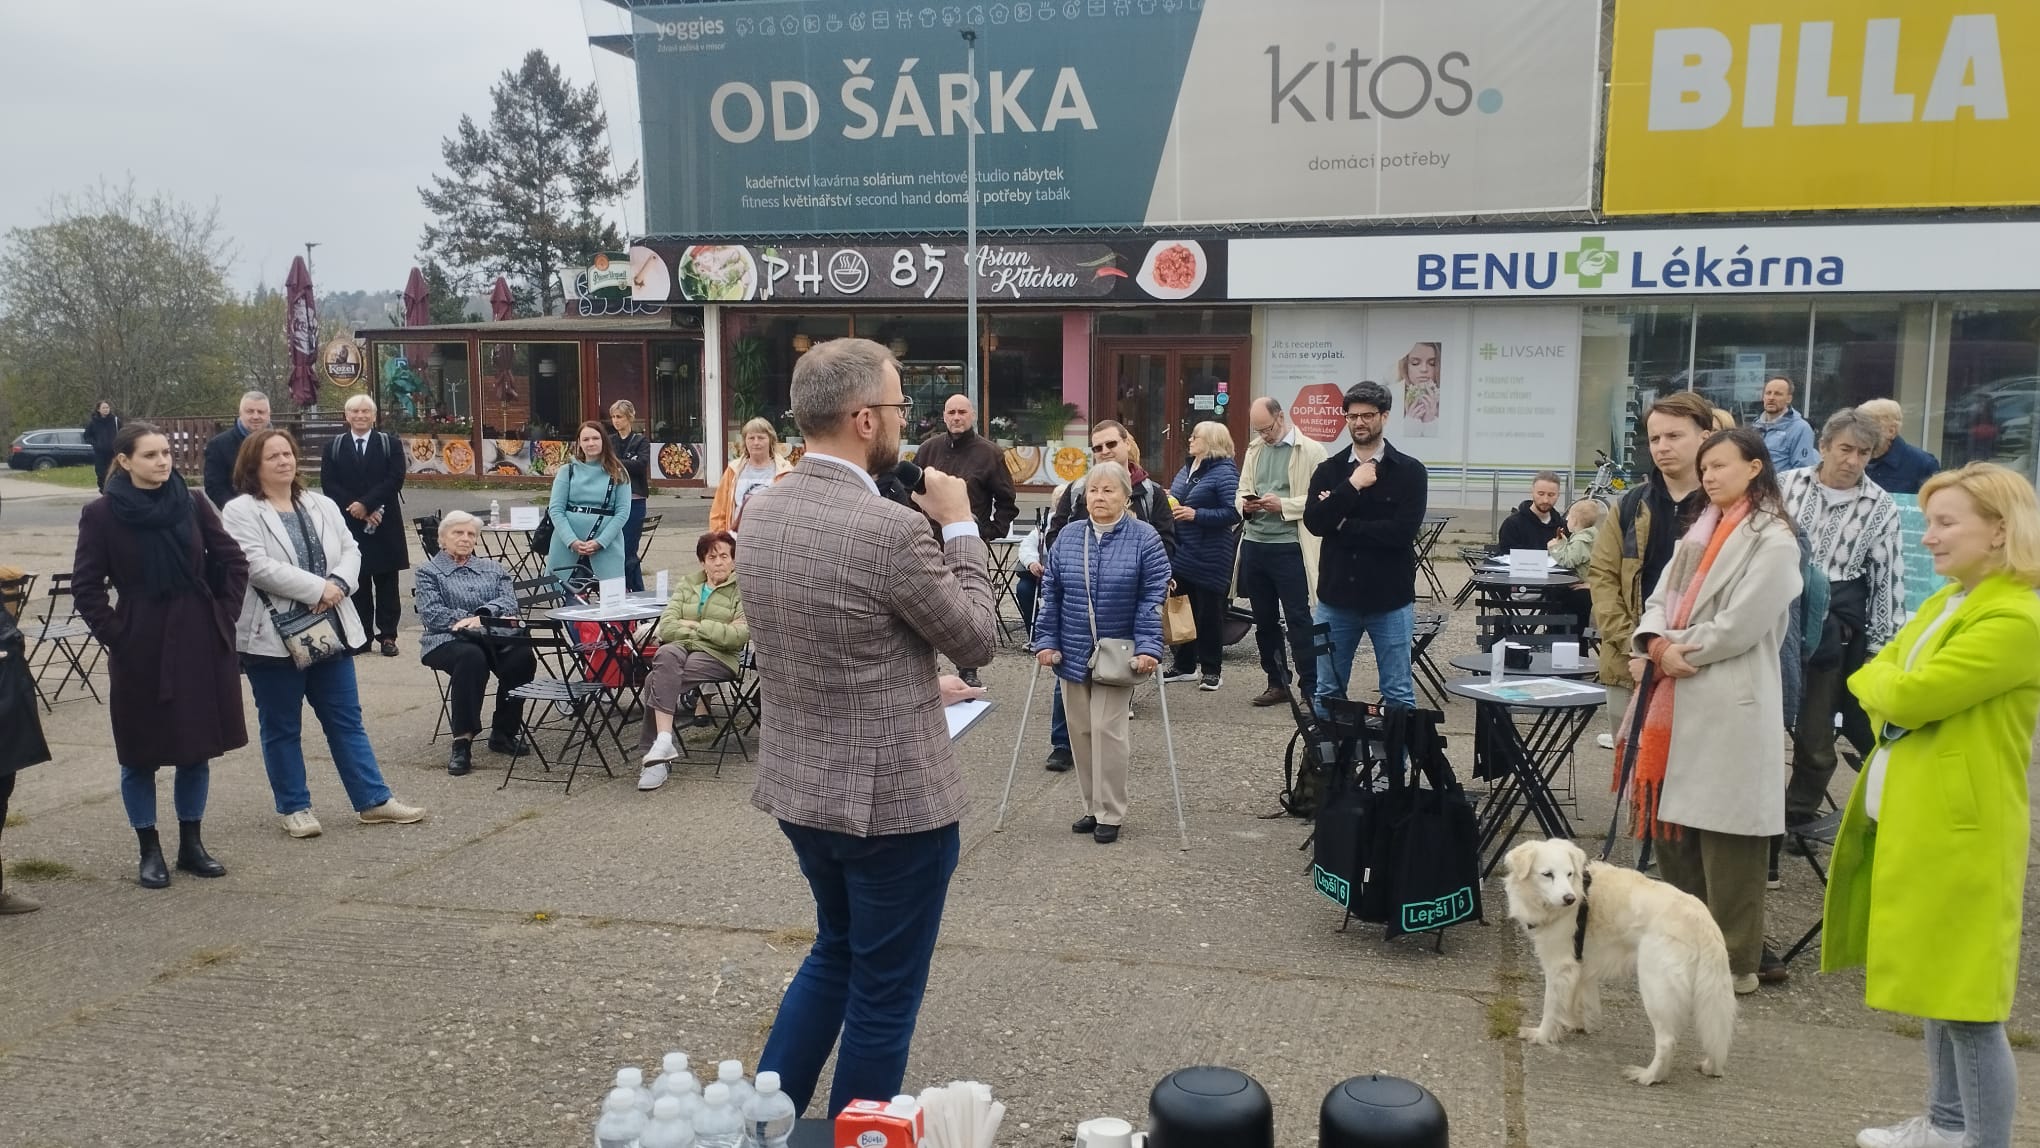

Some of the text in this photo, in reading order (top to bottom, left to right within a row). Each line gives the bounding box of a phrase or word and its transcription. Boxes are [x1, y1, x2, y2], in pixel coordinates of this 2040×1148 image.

[656, 16, 724, 41] yoggies
[1647, 13, 2010, 132] BILLA
[710, 58, 1098, 144] OD ŠÁRKA
[1308, 150, 1450, 172] domácí potřeby
[745, 174, 811, 189] kadeřnictví
[813, 173, 860, 187] kavárna
[863, 171, 915, 186] solárium
[918, 170, 968, 184] nehtové
[1013, 166, 1064, 185] nábytek
[741, 187, 1071, 208] fitness květinářství second hand domáí potřeby tabák
[889, 243, 946, 298] 85
[964, 245, 1031, 277] Asian
[1416, 243, 1844, 291] BENU Lékárna
[989, 265, 1078, 299] Kitchen
[1271, 351, 1277, 359] k
[1278, 350, 1297, 359] nám
[1291, 340, 1333, 350] receptem
[1501, 344, 1567, 358] LIVSANE
[328, 364, 356, 375] Kozel
[1308, 394, 1330, 405] BEZ
[1310, 418, 1337, 426] RECEPT
[1317, 870, 1346, 899] Lepší 6
[1409, 895, 1465, 924] Lepší 6
